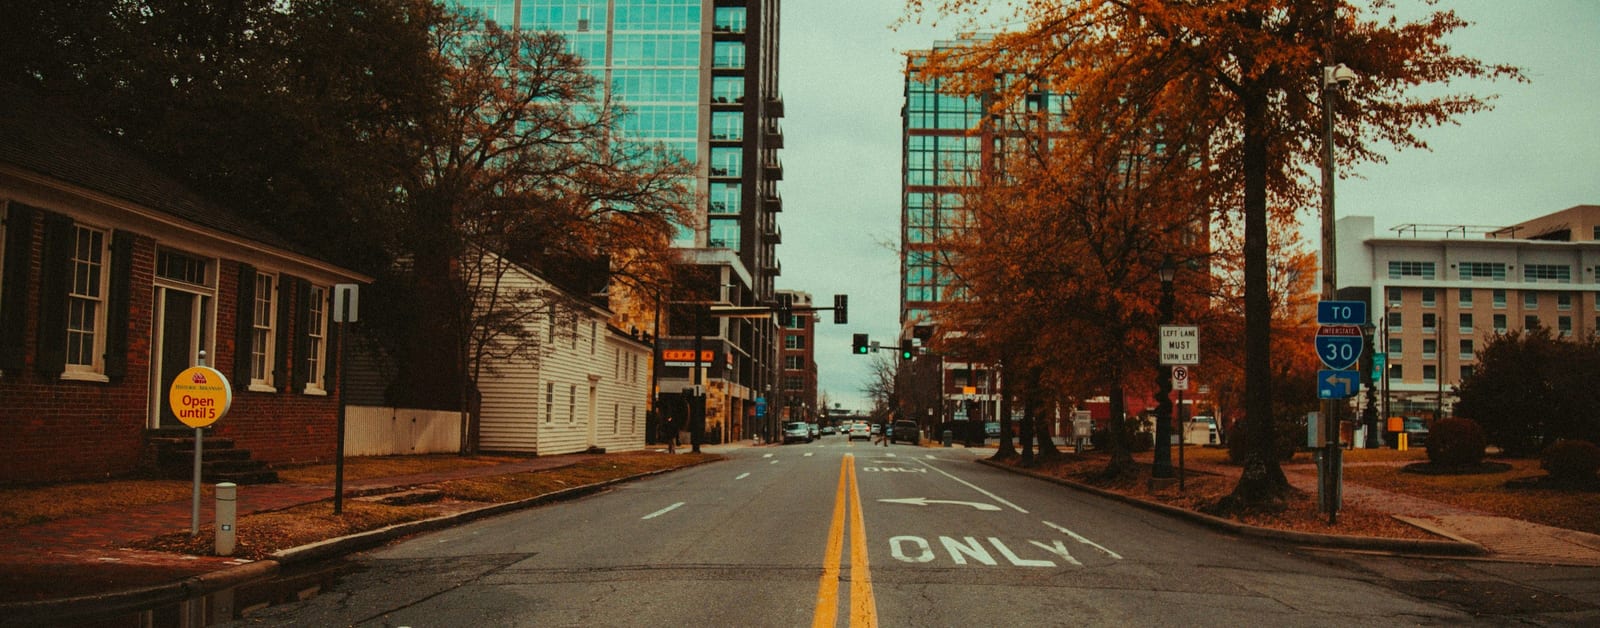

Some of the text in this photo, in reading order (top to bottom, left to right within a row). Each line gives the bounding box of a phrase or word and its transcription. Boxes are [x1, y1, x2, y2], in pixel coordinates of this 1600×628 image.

[1331, 306, 1351, 319] TO
[1169, 341, 1190, 349] MUST
[1326, 343, 1353, 361] 30
[182, 394, 214, 409] Open
[180, 407, 216, 419] until 5
[888, 535, 1083, 567] ONLY
